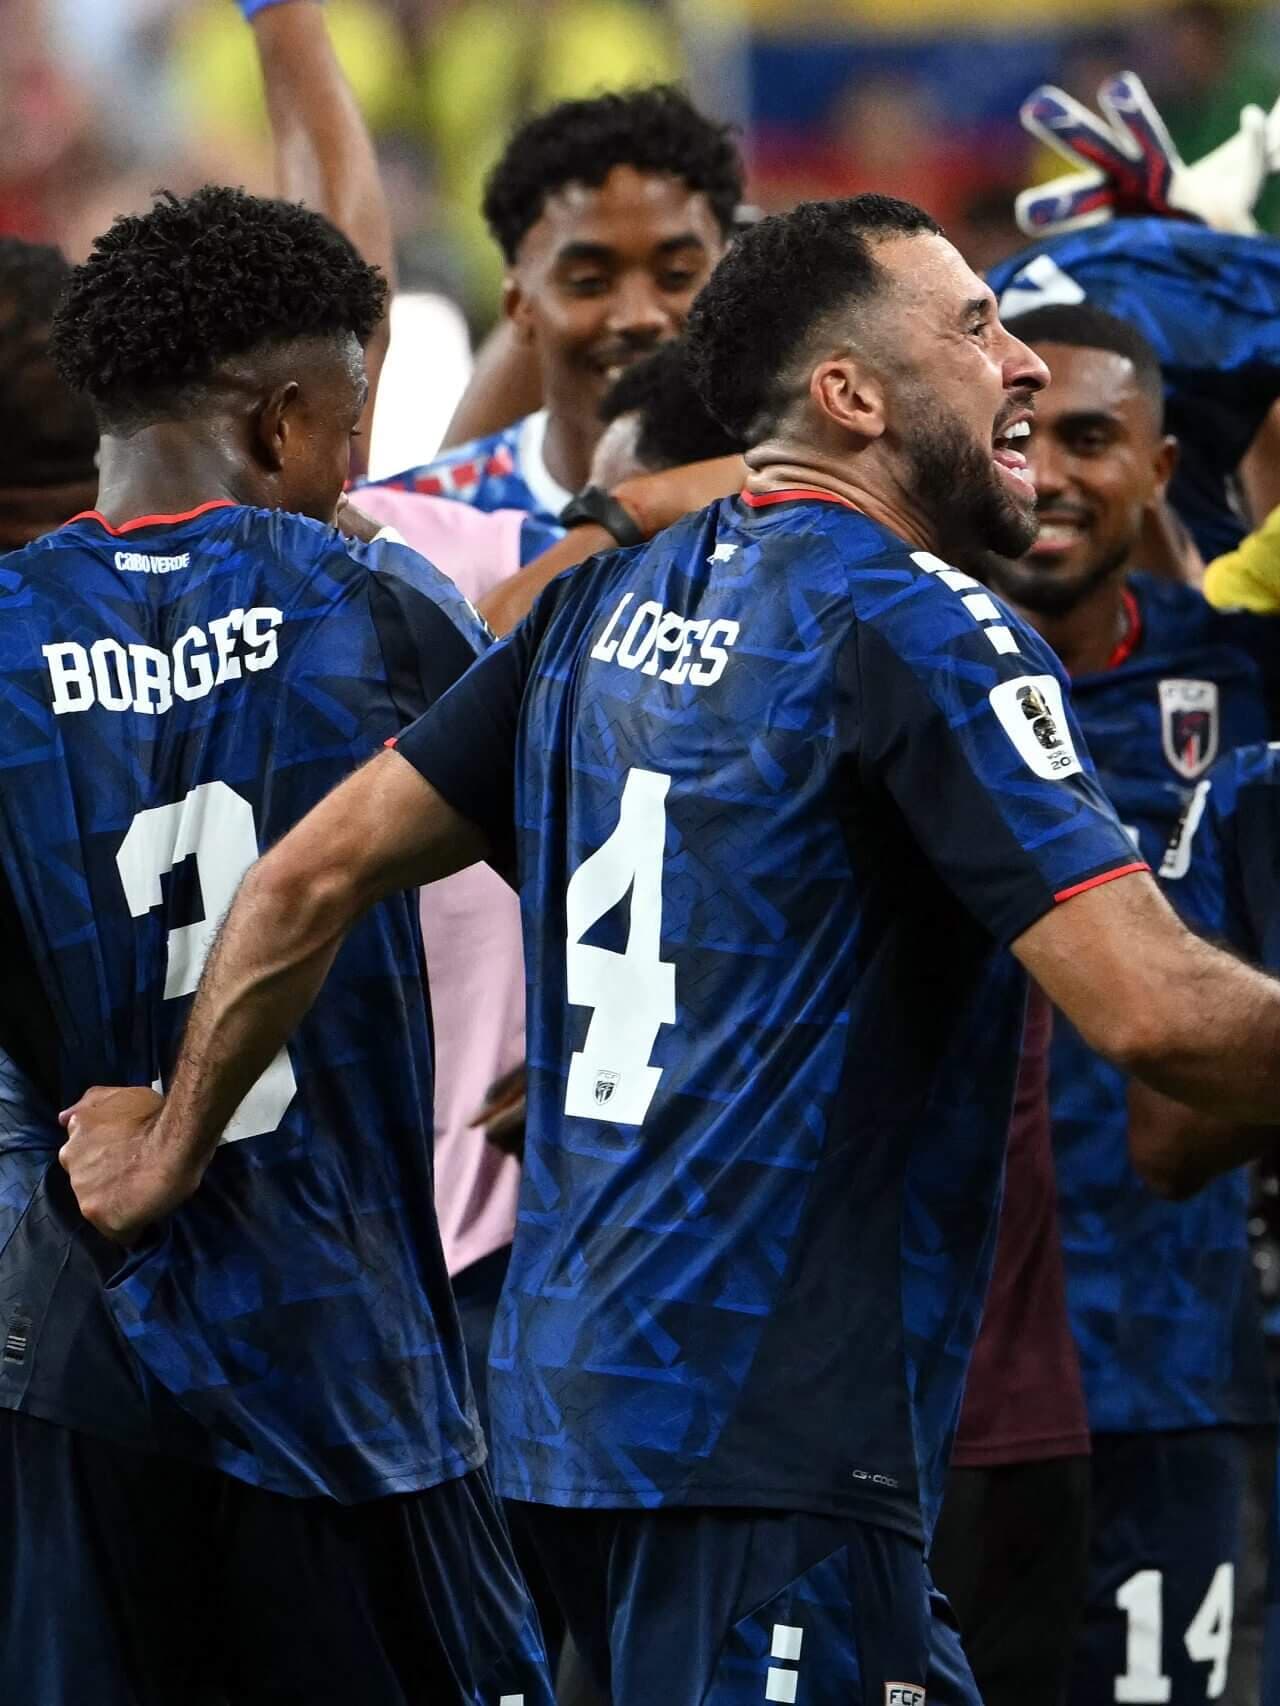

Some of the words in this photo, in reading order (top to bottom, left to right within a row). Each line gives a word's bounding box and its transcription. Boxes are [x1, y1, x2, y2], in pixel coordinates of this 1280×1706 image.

[43, 607, 283, 715] BORGES
[590, 592, 740, 687] LOPES
[564, 767, 676, 1126] 4
[1114, 1562, 1234, 1704] 14
[890, 1689, 922, 1706] FCF
